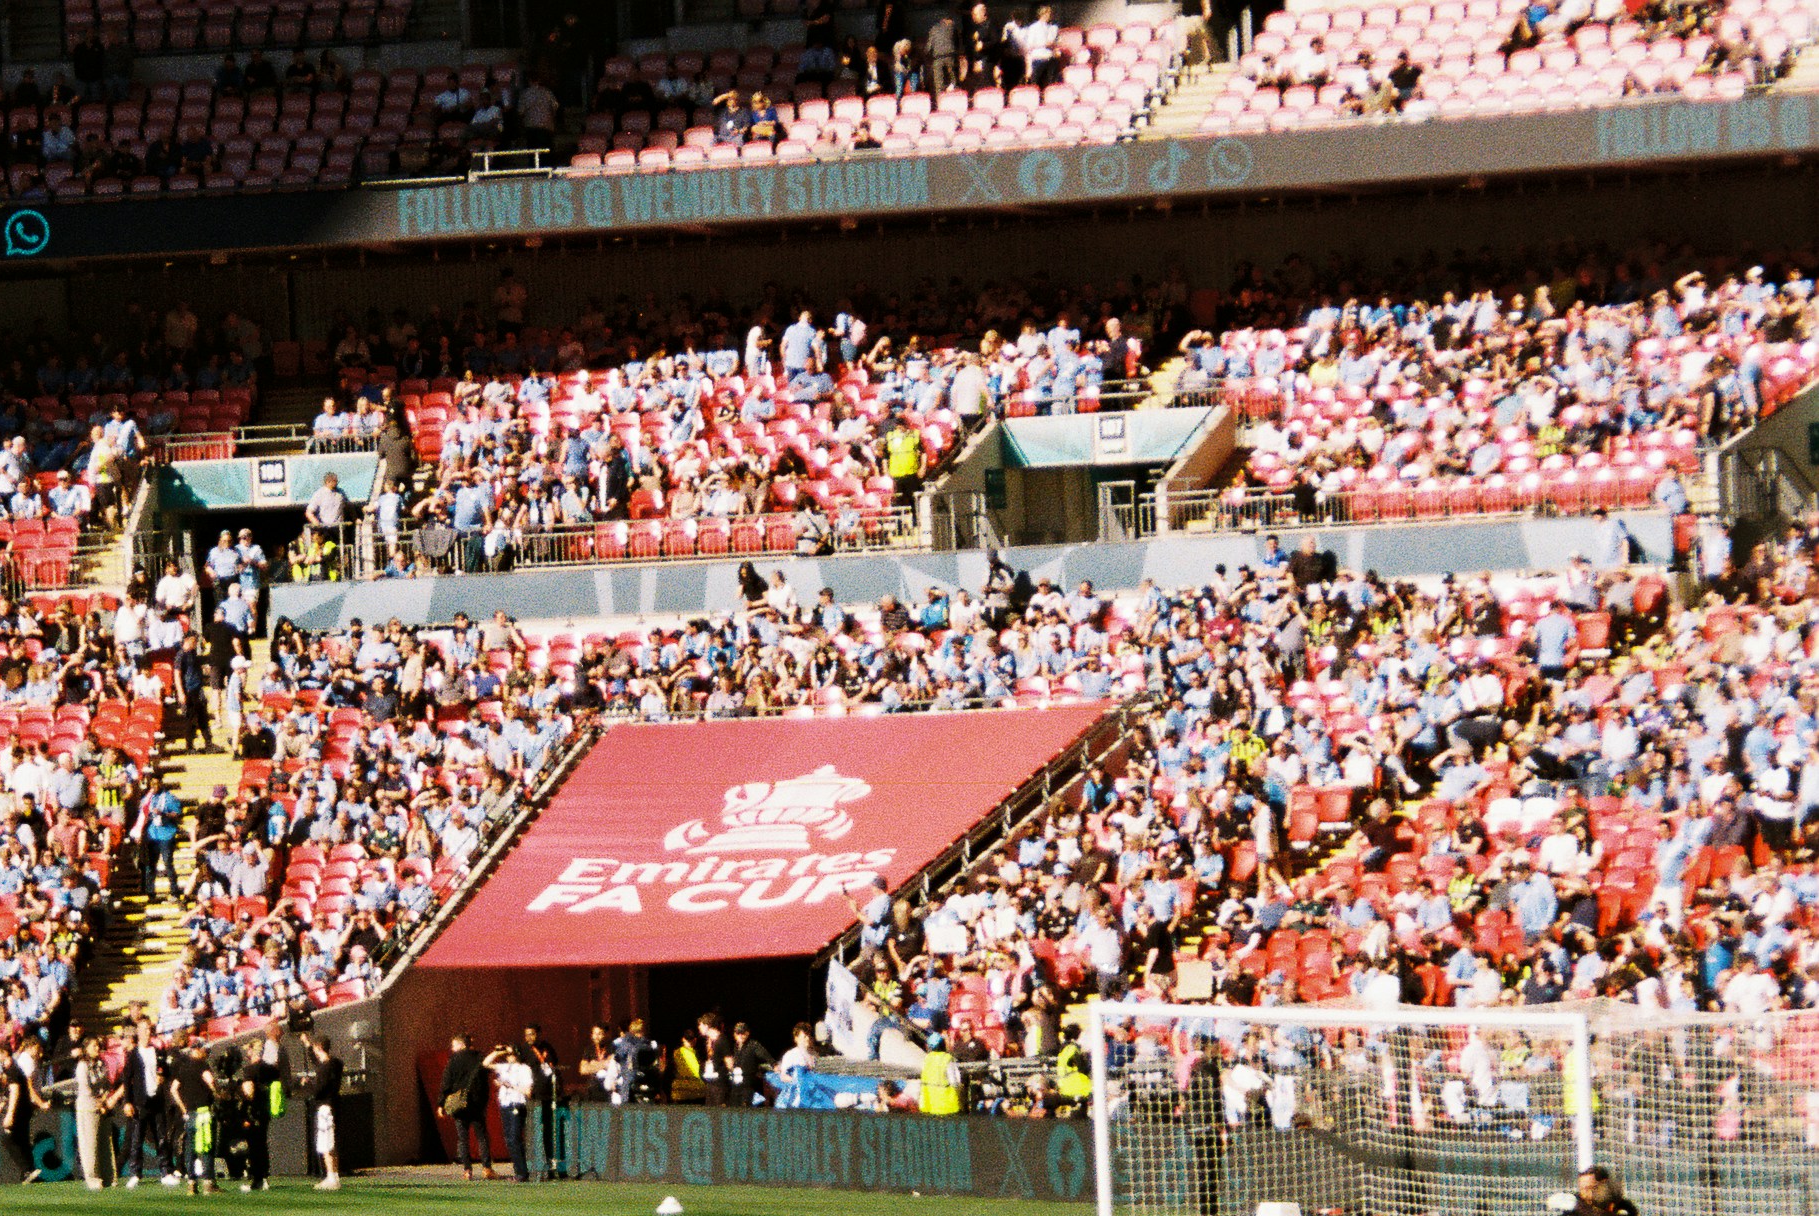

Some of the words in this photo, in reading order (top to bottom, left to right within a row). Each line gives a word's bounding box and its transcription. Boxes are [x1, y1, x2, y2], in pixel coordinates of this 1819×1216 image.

[1596, 103, 1719, 158] FOLLOW
[1732, 98, 1772, 151] US
[398, 182, 521, 235] FOLLOW
[532, 180, 574, 227] US
[584, 179, 613, 227] @
[620, 168, 775, 222] WEMBLEY
[784, 158, 928, 213] STADIUM
[526, 883, 642, 913] FA
[668, 870, 880, 913] CUP
[558, 848, 897, 883] Emirates
[622, 1110, 668, 1177] US
[682, 1110, 713, 1185] @
[721, 1111, 853, 1184] WEMBLEY
[860, 1115, 972, 1192] STADIUM
